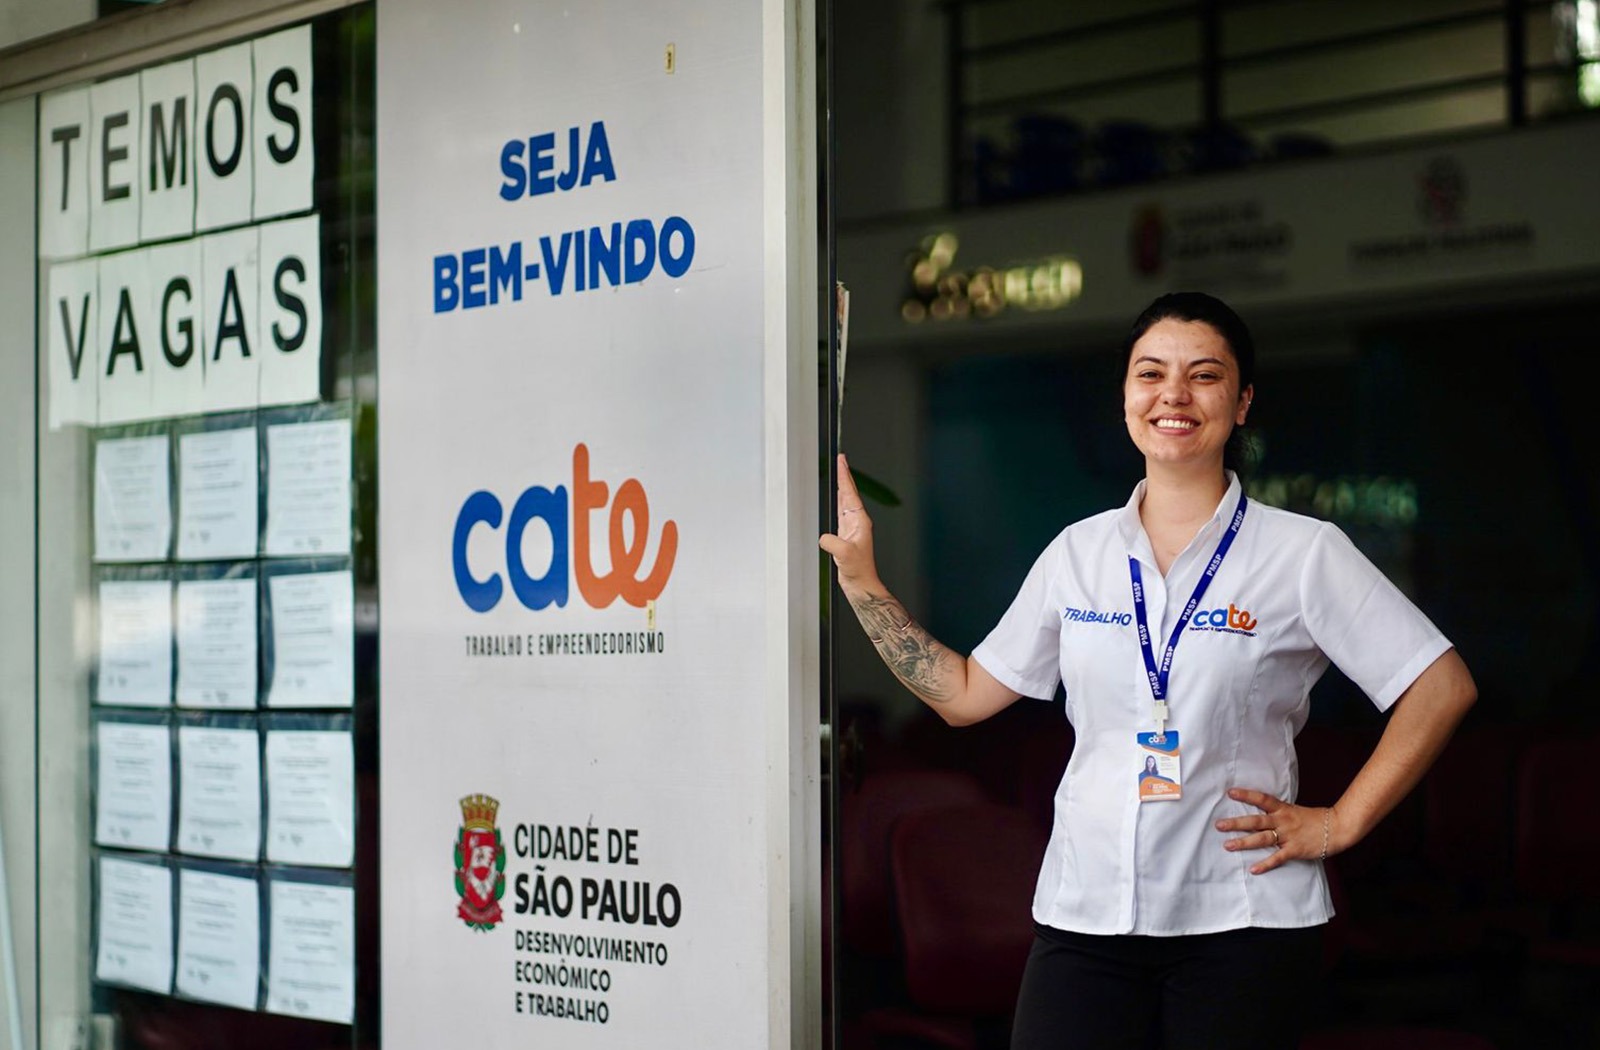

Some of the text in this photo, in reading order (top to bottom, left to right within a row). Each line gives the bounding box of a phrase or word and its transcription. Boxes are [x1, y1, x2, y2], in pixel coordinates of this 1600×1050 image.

[52, 67, 300, 212] TEMOS
[500, 121, 616, 201] SEJA
[433, 216, 695, 314] BEM-VINDO
[59, 256, 308, 380] VAGAS
[452, 442, 678, 613] cate
[1231, 510, 1244, 532] PMSP
[1206, 554, 1222, 577] PMSP
[1133, 582, 1142, 603] PMSP
[1063, 607, 1132, 626] TRABALHO
[1182, 598, 1197, 621] PMSP
[1193, 603, 1257, 631] cate
[465, 632, 664, 656] TRABALHO E EMPREENDEDORISMO
[1141, 624, 1149, 646] PMSP
[1162, 645, 1174, 672] PMSP
[1148, 670, 1161, 696] PMSP
[514, 823, 638, 865] CIDADE DE
[514, 865, 681, 928] SÃO PAULO
[515, 930, 667, 966] DESENVOLVIMENTO
[515, 959, 611, 992] ECONÔMICO
[515, 992, 609, 1024] E TRABALHO
